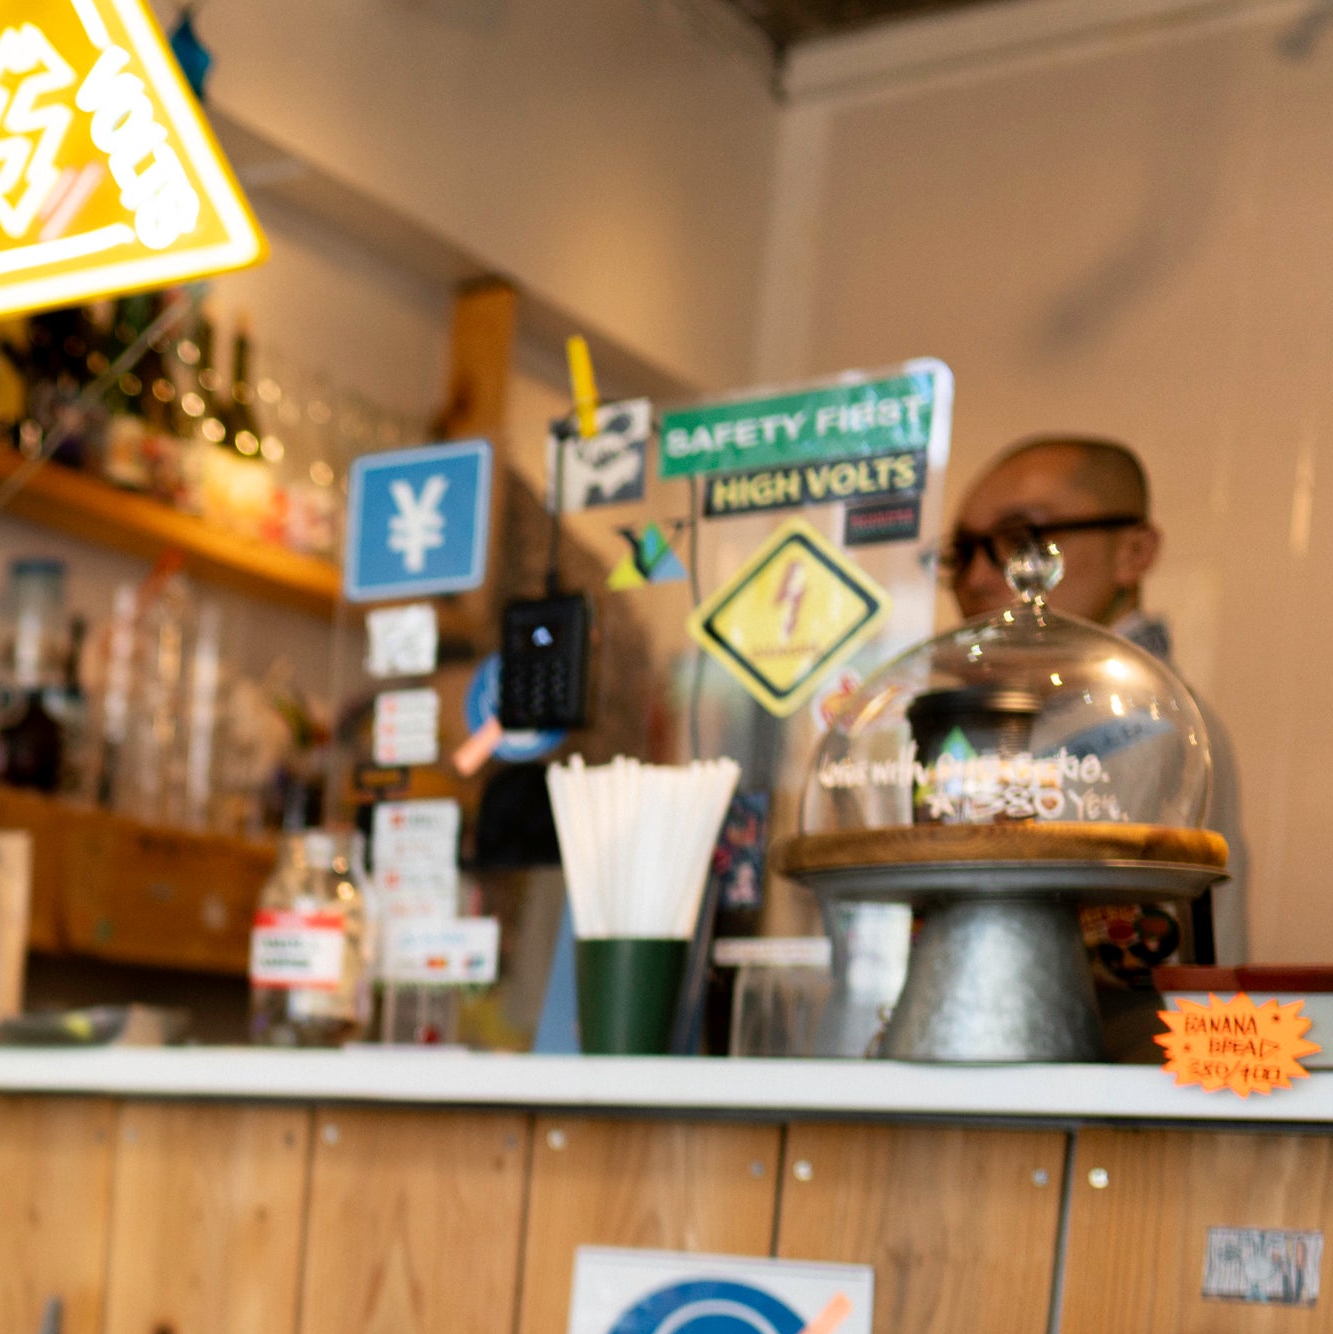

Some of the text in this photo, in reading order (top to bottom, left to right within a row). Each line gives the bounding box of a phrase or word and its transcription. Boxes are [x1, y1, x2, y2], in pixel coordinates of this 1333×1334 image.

[666, 394, 924, 458] SAFETY FIRST
[712, 455, 917, 511] HIGH VOLTS
[1184, 1012, 1259, 1036] BANANA
[1209, 1037, 1280, 1059] BREAD
